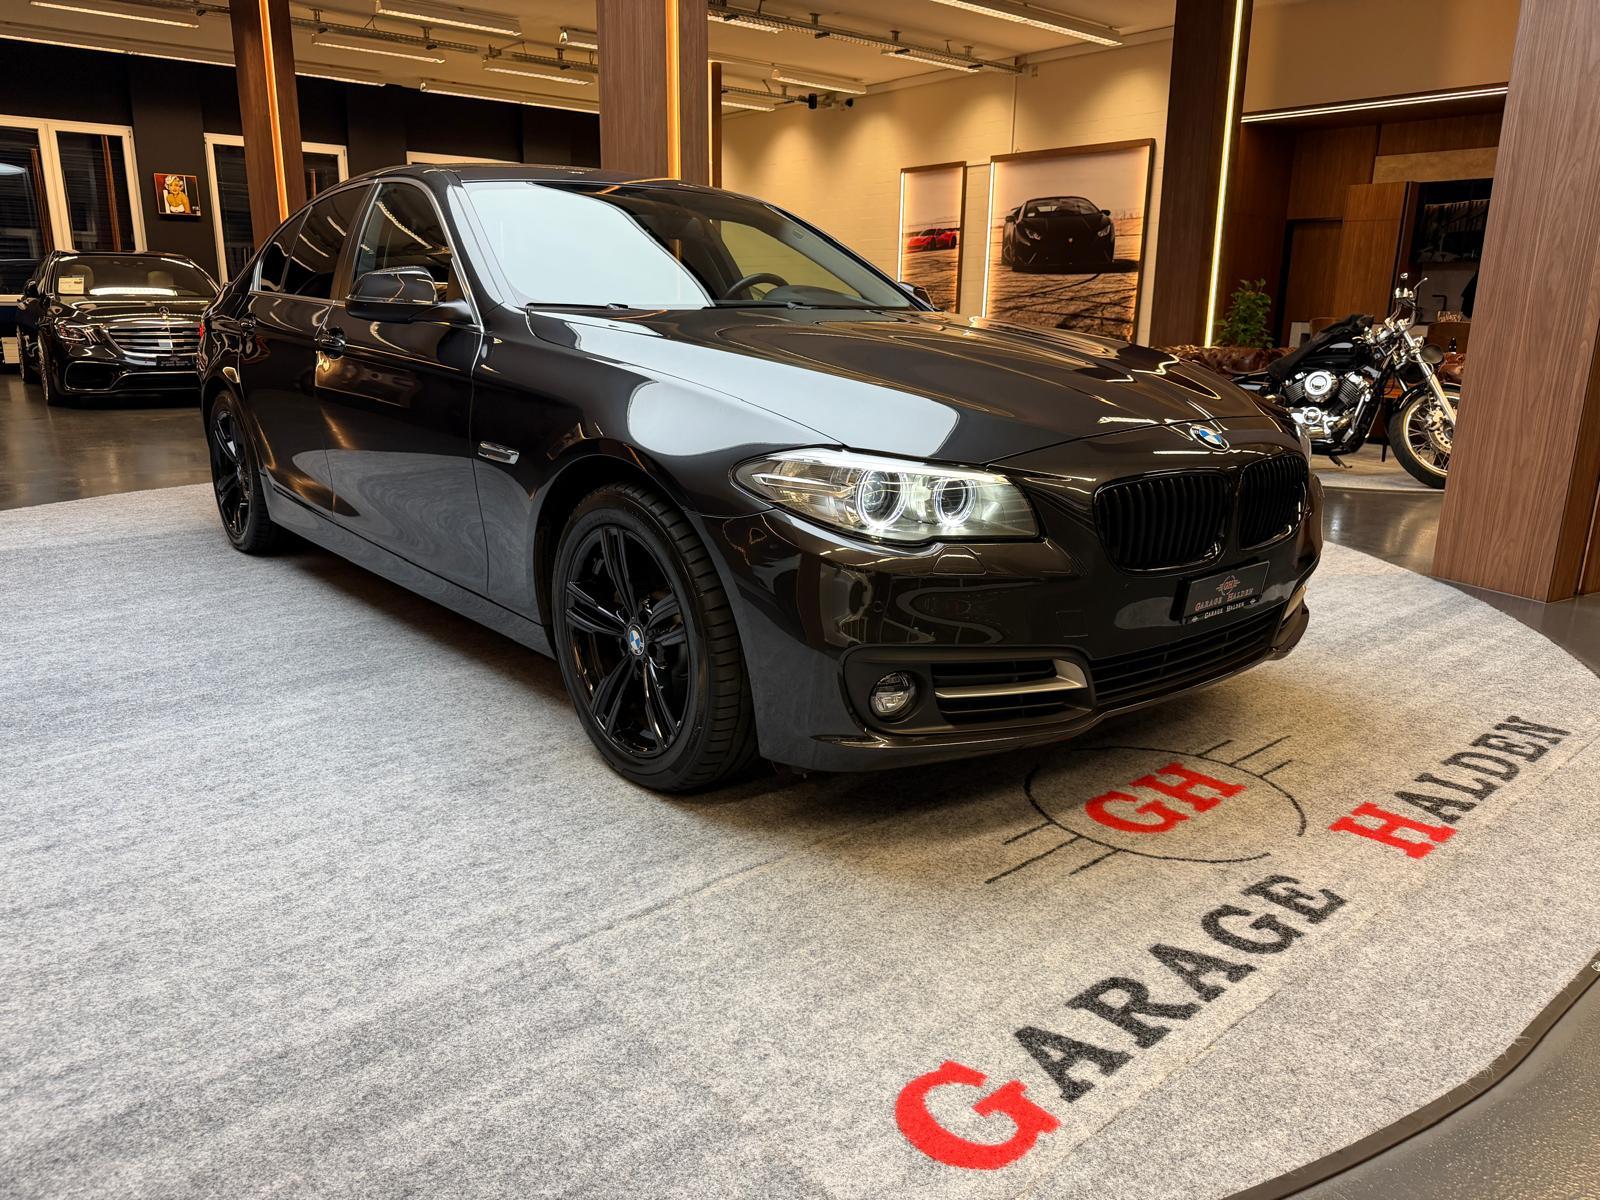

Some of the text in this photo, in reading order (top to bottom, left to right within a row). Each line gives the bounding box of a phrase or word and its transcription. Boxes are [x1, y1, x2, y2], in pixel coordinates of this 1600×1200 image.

[1194, 596, 1223, 612] GARAGE
[1085, 763, 1246, 834] GH
[895, 716, 1571, 1170] GARAGE HALDEN
